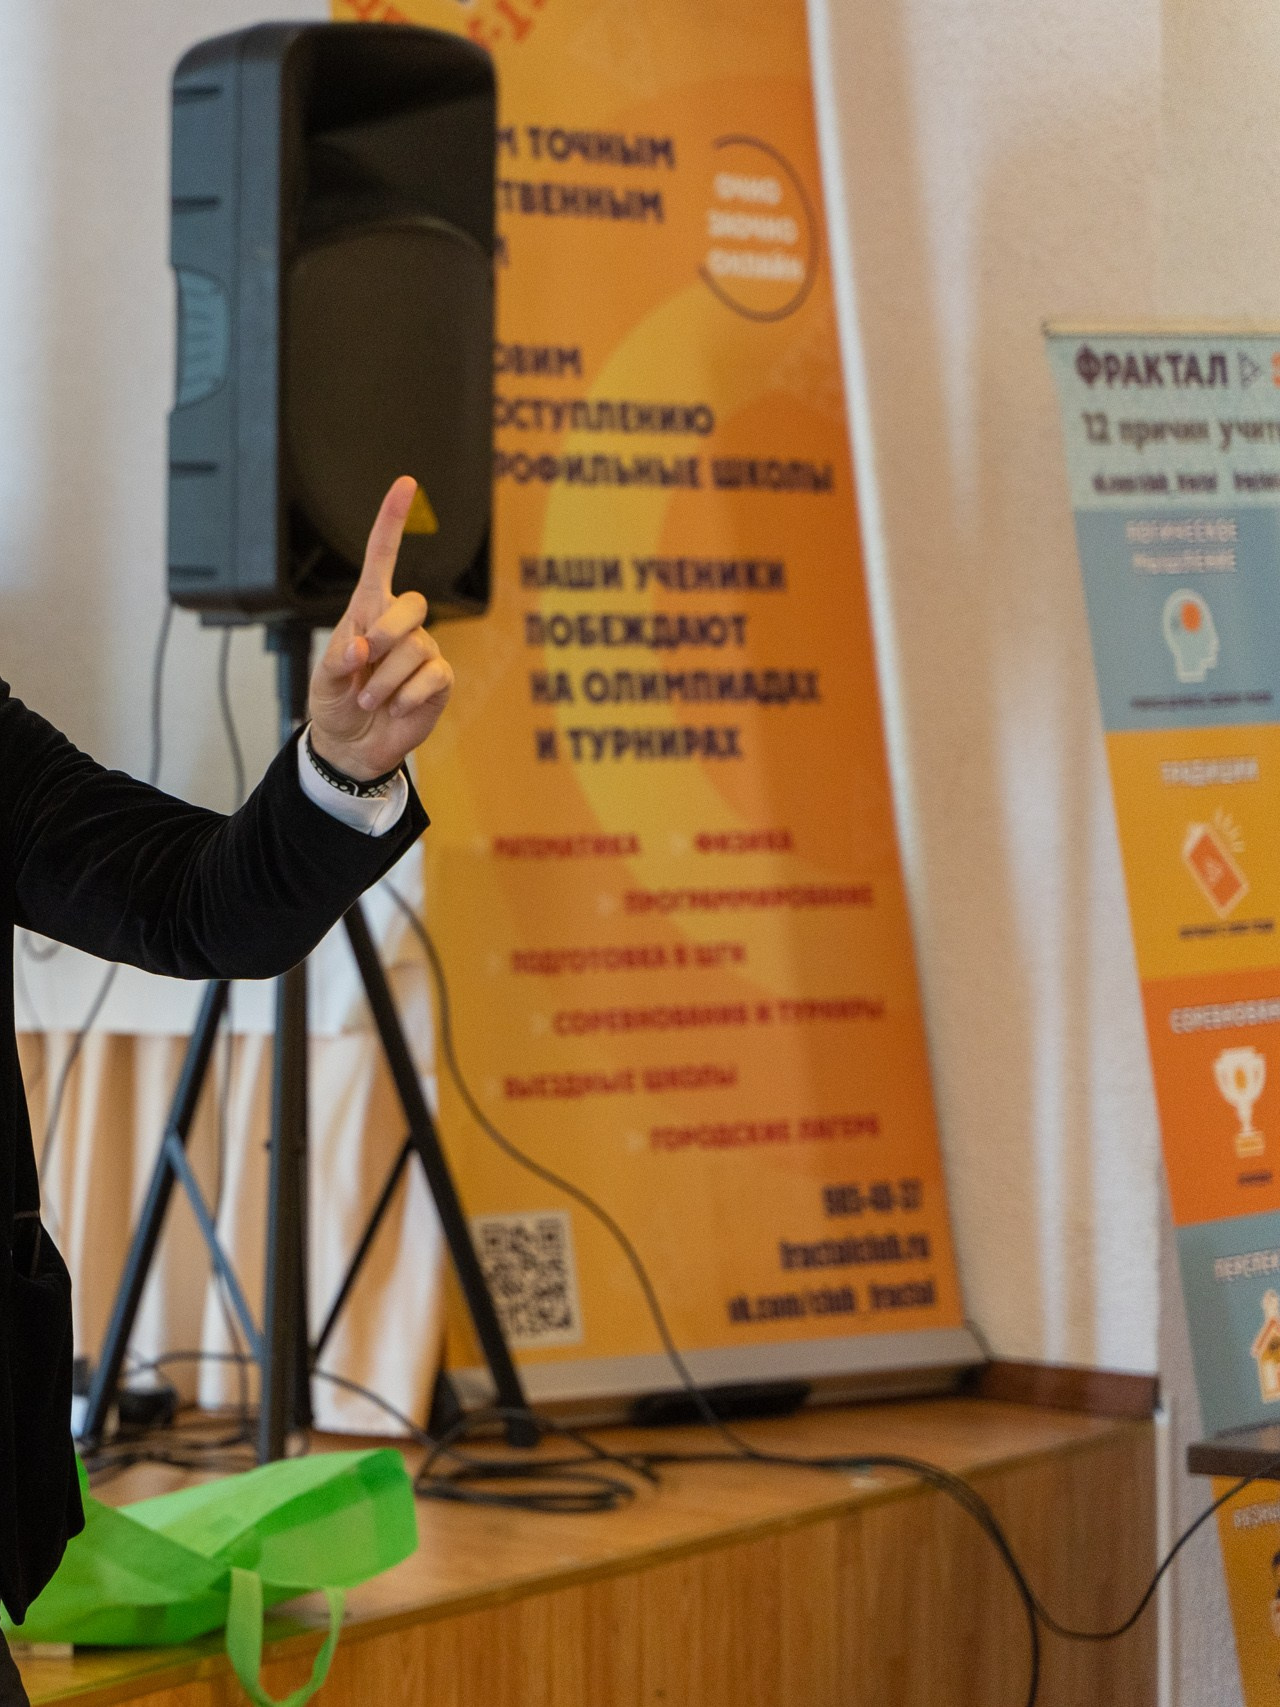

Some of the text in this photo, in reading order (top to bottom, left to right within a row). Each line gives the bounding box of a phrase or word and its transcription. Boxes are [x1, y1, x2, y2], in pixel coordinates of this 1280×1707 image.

[527, 124, 676, 170] ТОЧНЫМ
[1075, 344, 1228, 389] ФРАКТАЛ
[1082, 411, 1110, 444] 12
[1219, 419, 1280, 453] учит
[712, 458, 835, 493] ШКОЛЫ
[522, 556, 787, 592] НАШИ УЧЕНИКИ
[526, 613, 747, 650] ПОБЕЖДАЮТ
[530, 669, 821, 705] НА ОЛИМПИАДАХ
[535, 727, 743, 762] И ТУРНИРАХ
[694, 828, 793, 855] ФИЗИКА
